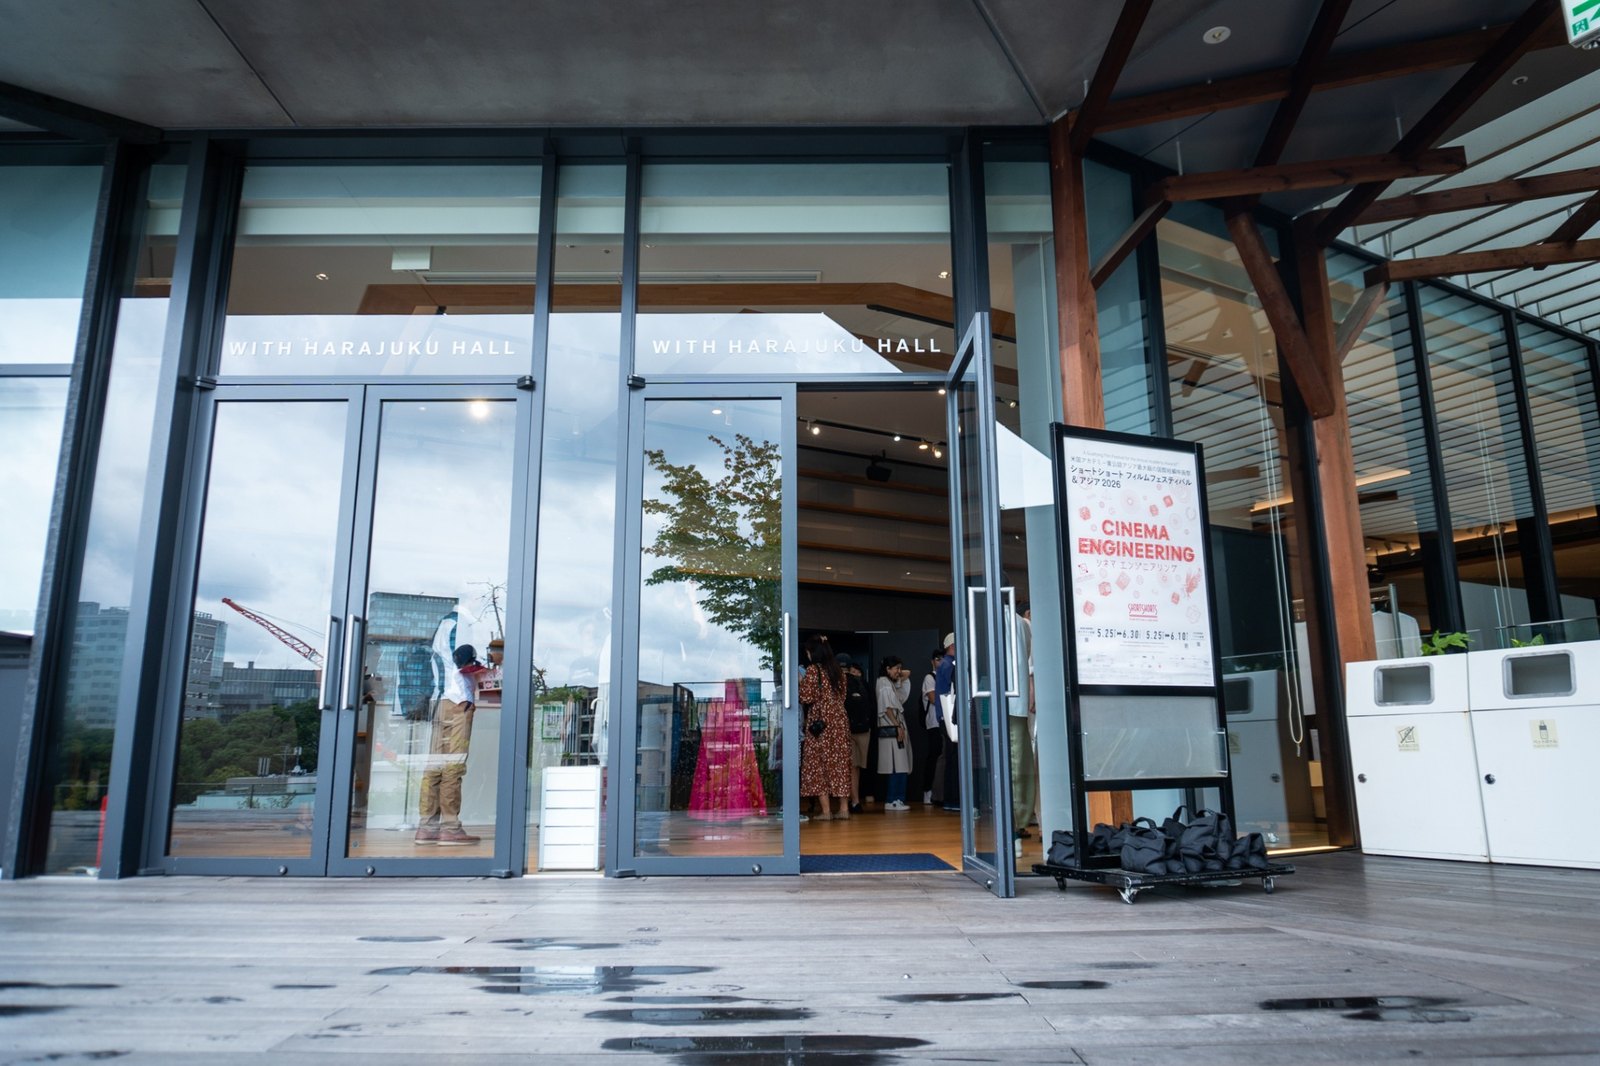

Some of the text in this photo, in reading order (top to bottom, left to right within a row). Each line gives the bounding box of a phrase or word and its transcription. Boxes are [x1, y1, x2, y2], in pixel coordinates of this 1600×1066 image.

[229, 340, 516, 356] WITH HARAJUKU HALL
[652, 338, 941, 354] WITH HARAJUKU HALL
[1071, 465, 1192, 486] ショートショート フィルムフェスティバル
[1101, 519, 1170, 540] CINEMA
[1078, 537, 1195, 562] ENGINEERING
